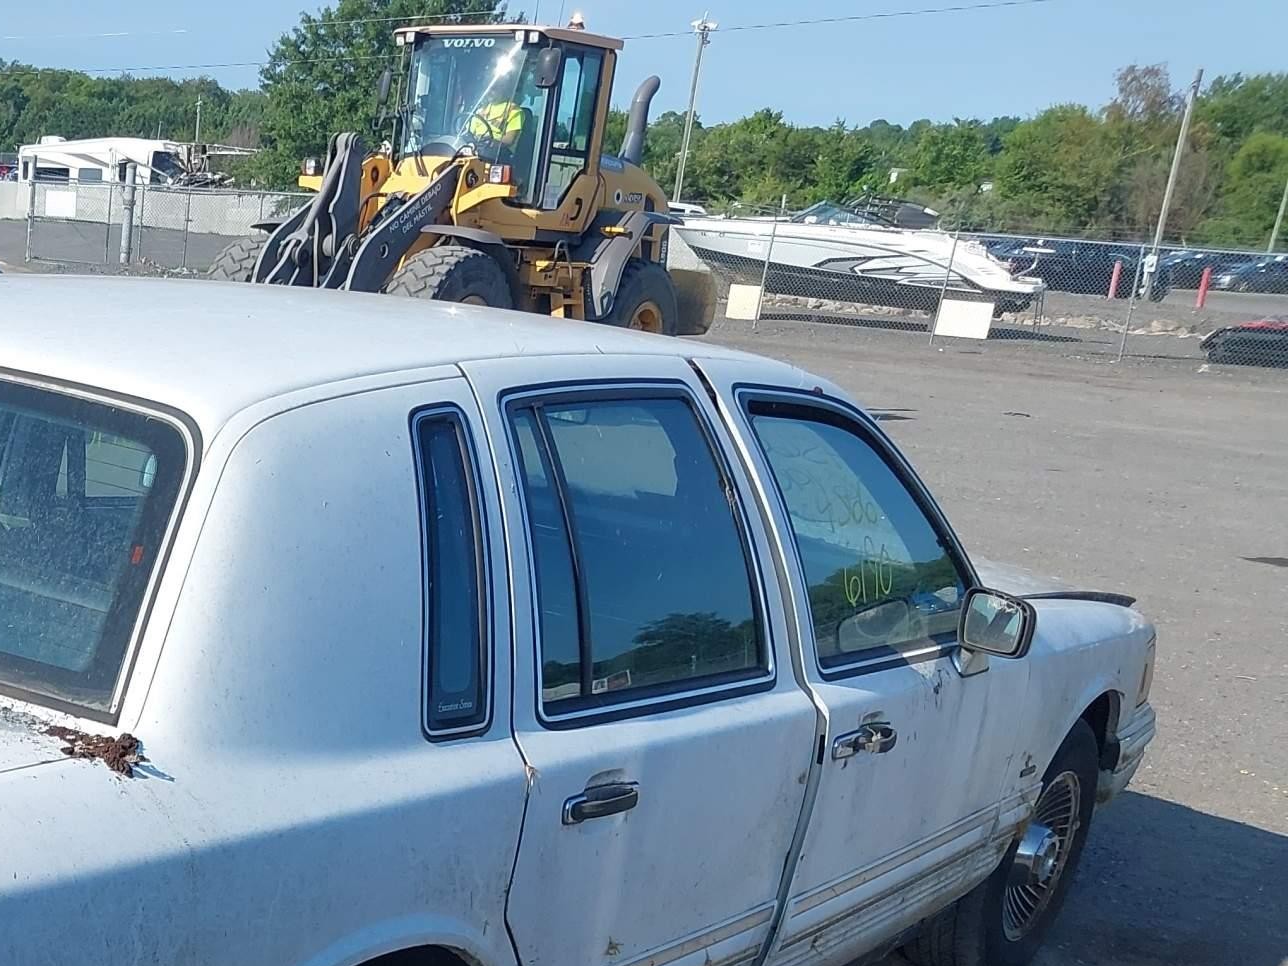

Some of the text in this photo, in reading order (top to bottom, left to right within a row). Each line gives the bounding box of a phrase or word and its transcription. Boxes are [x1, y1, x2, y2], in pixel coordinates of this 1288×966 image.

[442, 38, 496, 48] VOLVO
[389, 183, 442, 233] NO CAMINE DEBAJO
[402, 223, 414, 234] DEL
[844, 536, 893, 607] 6190
